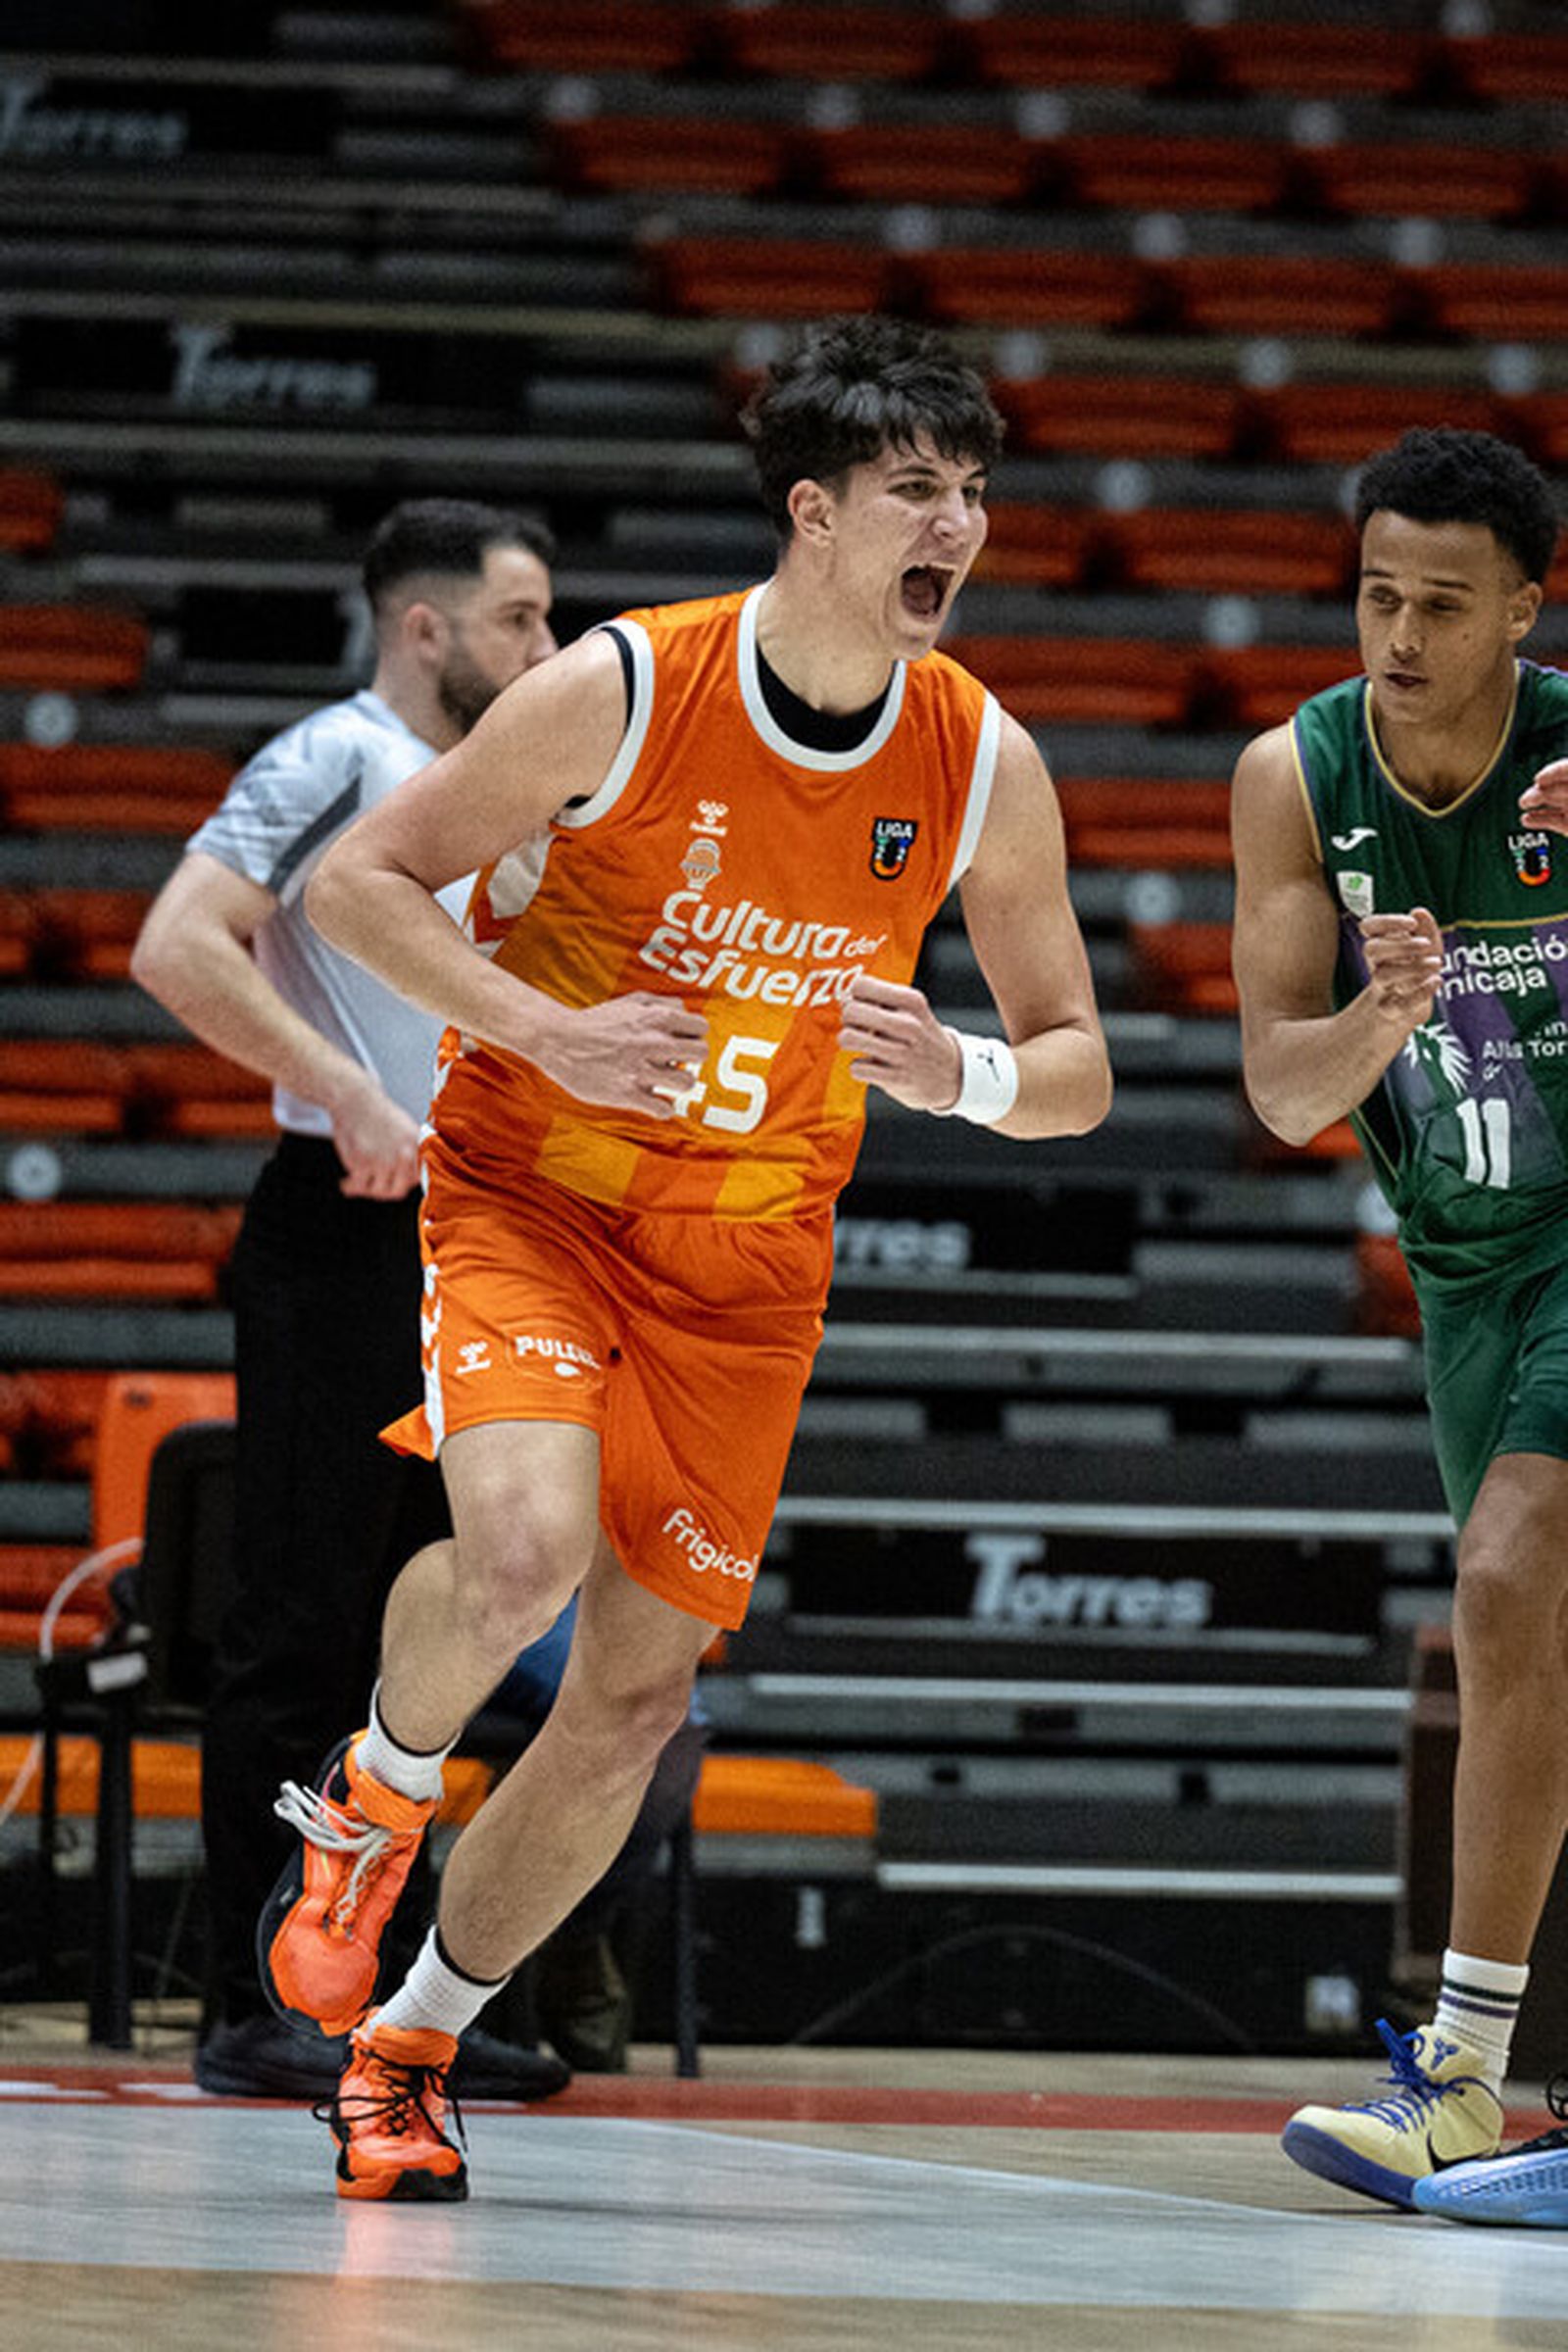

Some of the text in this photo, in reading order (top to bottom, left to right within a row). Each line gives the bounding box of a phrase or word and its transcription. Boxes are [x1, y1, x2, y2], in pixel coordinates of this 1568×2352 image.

[1507, 832, 1549, 851] LIGA
[662, 890, 851, 960] Cultura
[1440, 933, 1568, 974] undació
[639, 926, 863, 1007] Esfuerzo
[1457, 1098, 1510, 1190] 11
[833, 1217, 970, 1272] rres
[964, 1534, 1213, 1627] Torres
